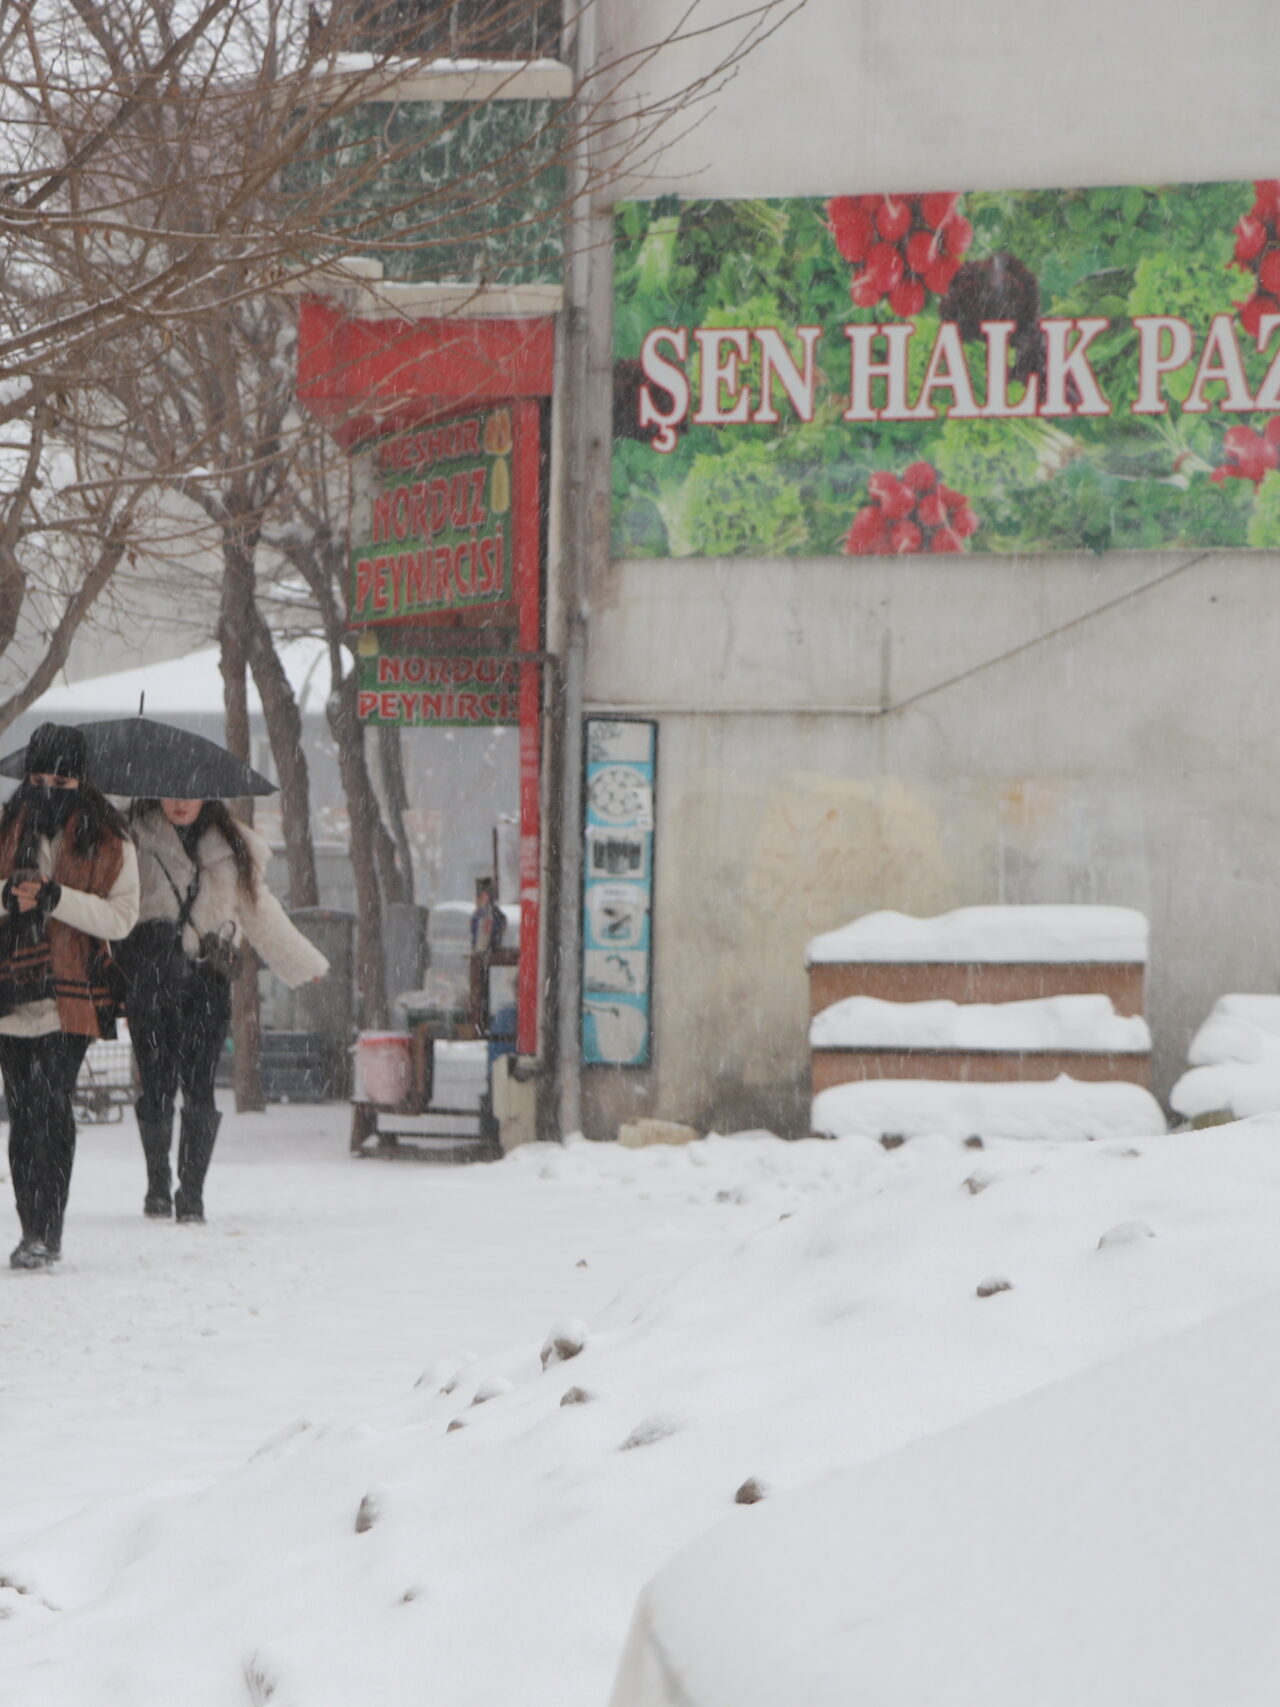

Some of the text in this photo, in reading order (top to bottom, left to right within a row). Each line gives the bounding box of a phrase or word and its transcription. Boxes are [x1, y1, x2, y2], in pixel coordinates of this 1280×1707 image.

[638, 325, 822, 454] ŞEN
[843, 317, 1111, 422] HALK
[378, 419, 481, 474] MEŞHUR
[355, 522, 505, 614] PEYNİRCİSİ
